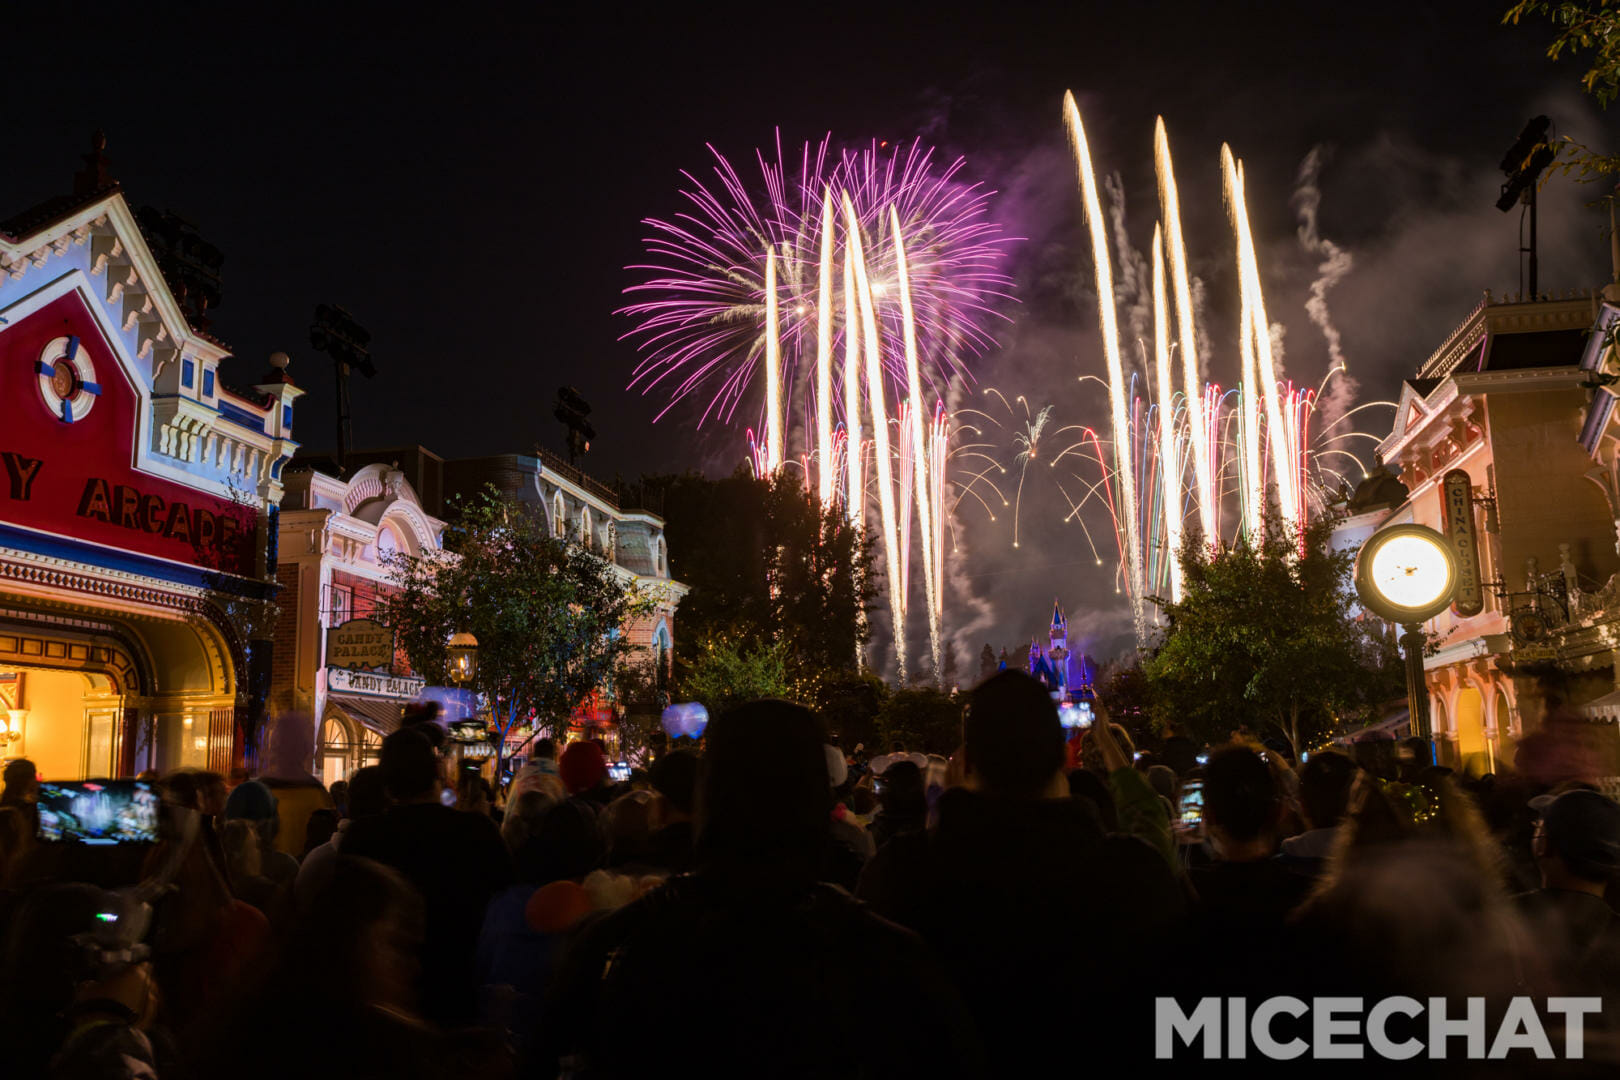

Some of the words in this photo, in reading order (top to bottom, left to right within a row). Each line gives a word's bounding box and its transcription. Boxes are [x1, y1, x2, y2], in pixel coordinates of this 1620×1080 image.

[77, 478, 239, 551] ARCADE
[1452, 488, 1467, 534] CHINA
[1458, 539, 1474, 596] CLOSET
[333, 645, 388, 657] PALACE
[337, 633, 384, 644] CANDY
